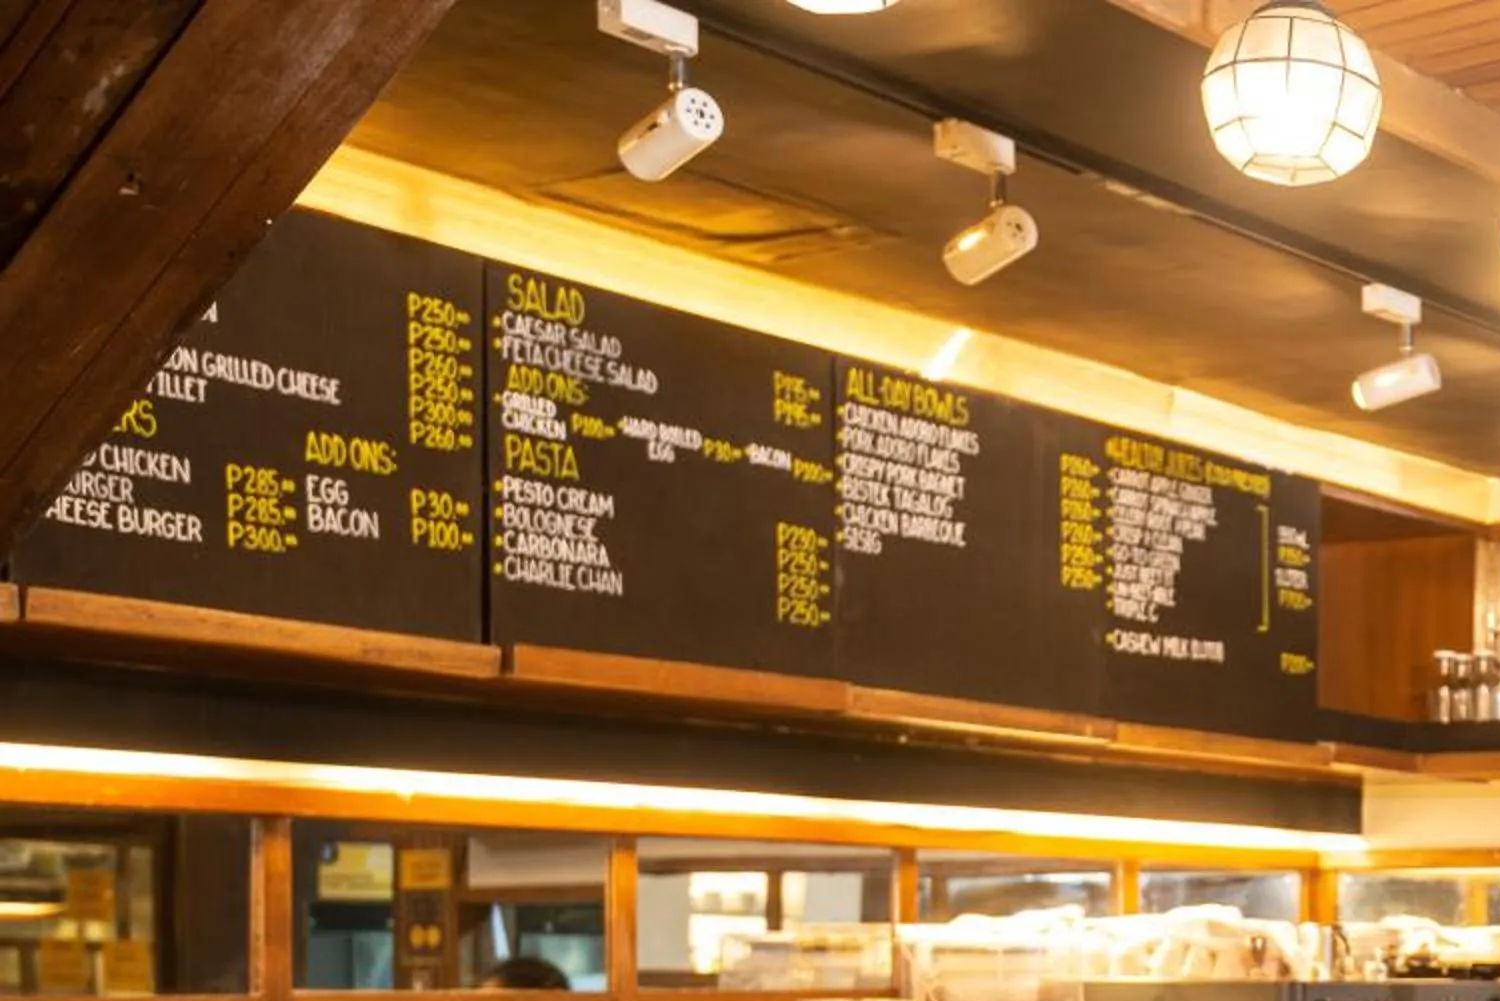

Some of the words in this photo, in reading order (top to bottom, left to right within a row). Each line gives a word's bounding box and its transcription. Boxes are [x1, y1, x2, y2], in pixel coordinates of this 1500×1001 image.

[508, 273, 585, 325] SALAD
[502, 311, 567, 347] CAESAR
[570, 327, 623, 359] SALAD
[147, 371, 207, 403] ILLET
[202, 352, 275, 390] GRILLED
[277, 367, 342, 405] CHEESE
[507, 363, 544, 395] ADD
[606, 360, 659, 395] SALAD
[912, 384, 969, 426] BOWLS
[100, 442, 191, 484] CHICKEN
[306, 431, 347, 466] ADD
[350, 437, 397, 475] ONS:
[505, 434, 579, 480] PASTA
[64, 471, 135, 503] URGER
[306, 474, 349, 505] EGG
[504, 475, 554, 508] PESTO
[557, 487, 614, 519] CREAM
[117, 504, 203, 543] BURGER
[307, 504, 380, 539] BACON
[504, 502, 599, 542] BOLOGNESE
[504, 530, 610, 568] CARBONARA
[505, 556, 576, 590] CHARLIE
[577, 565, 623, 596] CHAN
